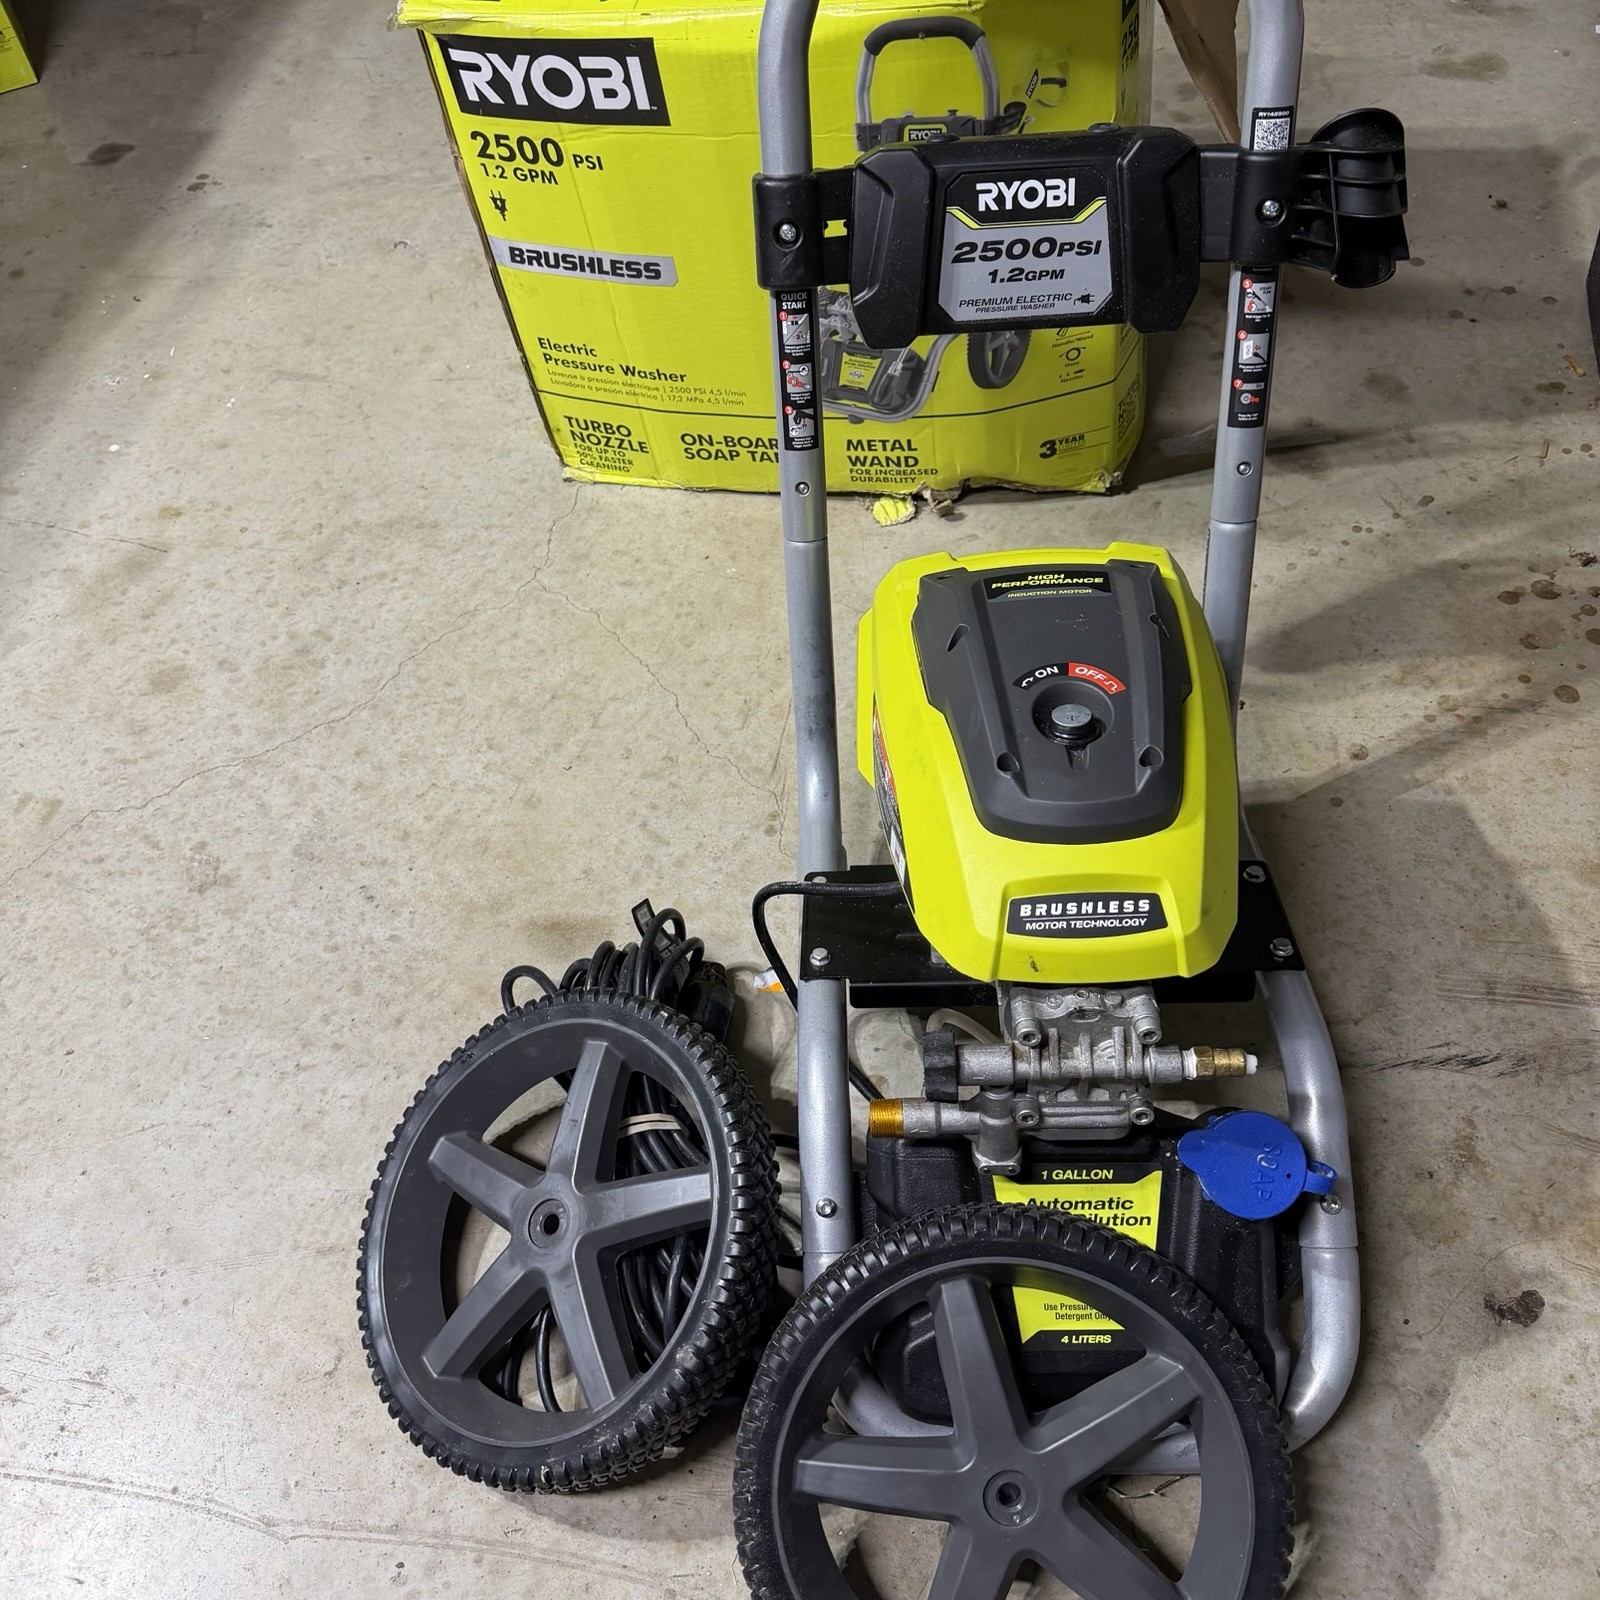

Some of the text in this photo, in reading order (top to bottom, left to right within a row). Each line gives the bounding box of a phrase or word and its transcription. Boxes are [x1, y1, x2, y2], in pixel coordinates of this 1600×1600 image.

[448, 48, 650, 110] RYOBI
[909, 130, 940, 140] RYO
[470, 130, 604, 171] 2500 PSI
[480, 162, 559, 186] 1.2 GPM
[975, 177, 1076, 212] RYOBI
[950, 236, 1103, 264] 2500PSI
[508, 246, 662, 280] BRUSHLESS
[987, 267, 1066, 284] 1.2GPM
[780, 292, 808, 301] QUICK
[958, 292, 1073, 308] PREMIUM ELECTRIC
[782, 301, 807, 310] START
[975, 302, 1056, 314] PRESSURE WASHER
[537, 337, 598, 358] Electric
[543, 353, 687, 383] Pressure Washer
[547, 369, 578, 380] Laveuse
[587, 378, 620, 388] pression
[669, 386, 692, 395] 2500
[693, 388, 707, 396] PSI
[550, 379, 586, 390] Lavadora
[563, 415, 632, 437] TURBO
[570, 429, 650, 454] NOZZLE
[574, 443, 592, 452] FOR
[680, 433, 779, 450] ON-BOAR
[846, 438, 918, 452] METAL
[1039, 439, 1057, 459] 3
[1058, 434, 1085, 446] YEAR
[599, 455, 634, 466] FASTER
[683, 447, 740, 461] SOAP
[847, 455, 919, 468] WAND
[875, 468, 938, 476] INCREASED
[850, 475, 917, 484] DURABILITY
[991, 577, 1104, 589] PERFORMANCE
[1027, 573, 1064, 581] HIGH
[1007, 590, 1057, 598] INDUCTION
[1034, 666, 1059, 679] ON
[1075, 666, 1106, 681] OFF
[1020, 899, 1150, 917] BRUSHLESS
[1025, 918, 1147, 931] MOTOR TECHNOLOGY
[1041, 1169, 1114, 1180] 1 GALLON
[1253, 1142, 1283, 1201] SOAP
[1072, 1213, 1152, 1226] ilution
[1043, 1303, 1058, 1311] Use
[1055, 1312, 1093, 1321] Detergent
[1060, 1334, 1112, 1344] 4 LITERS
